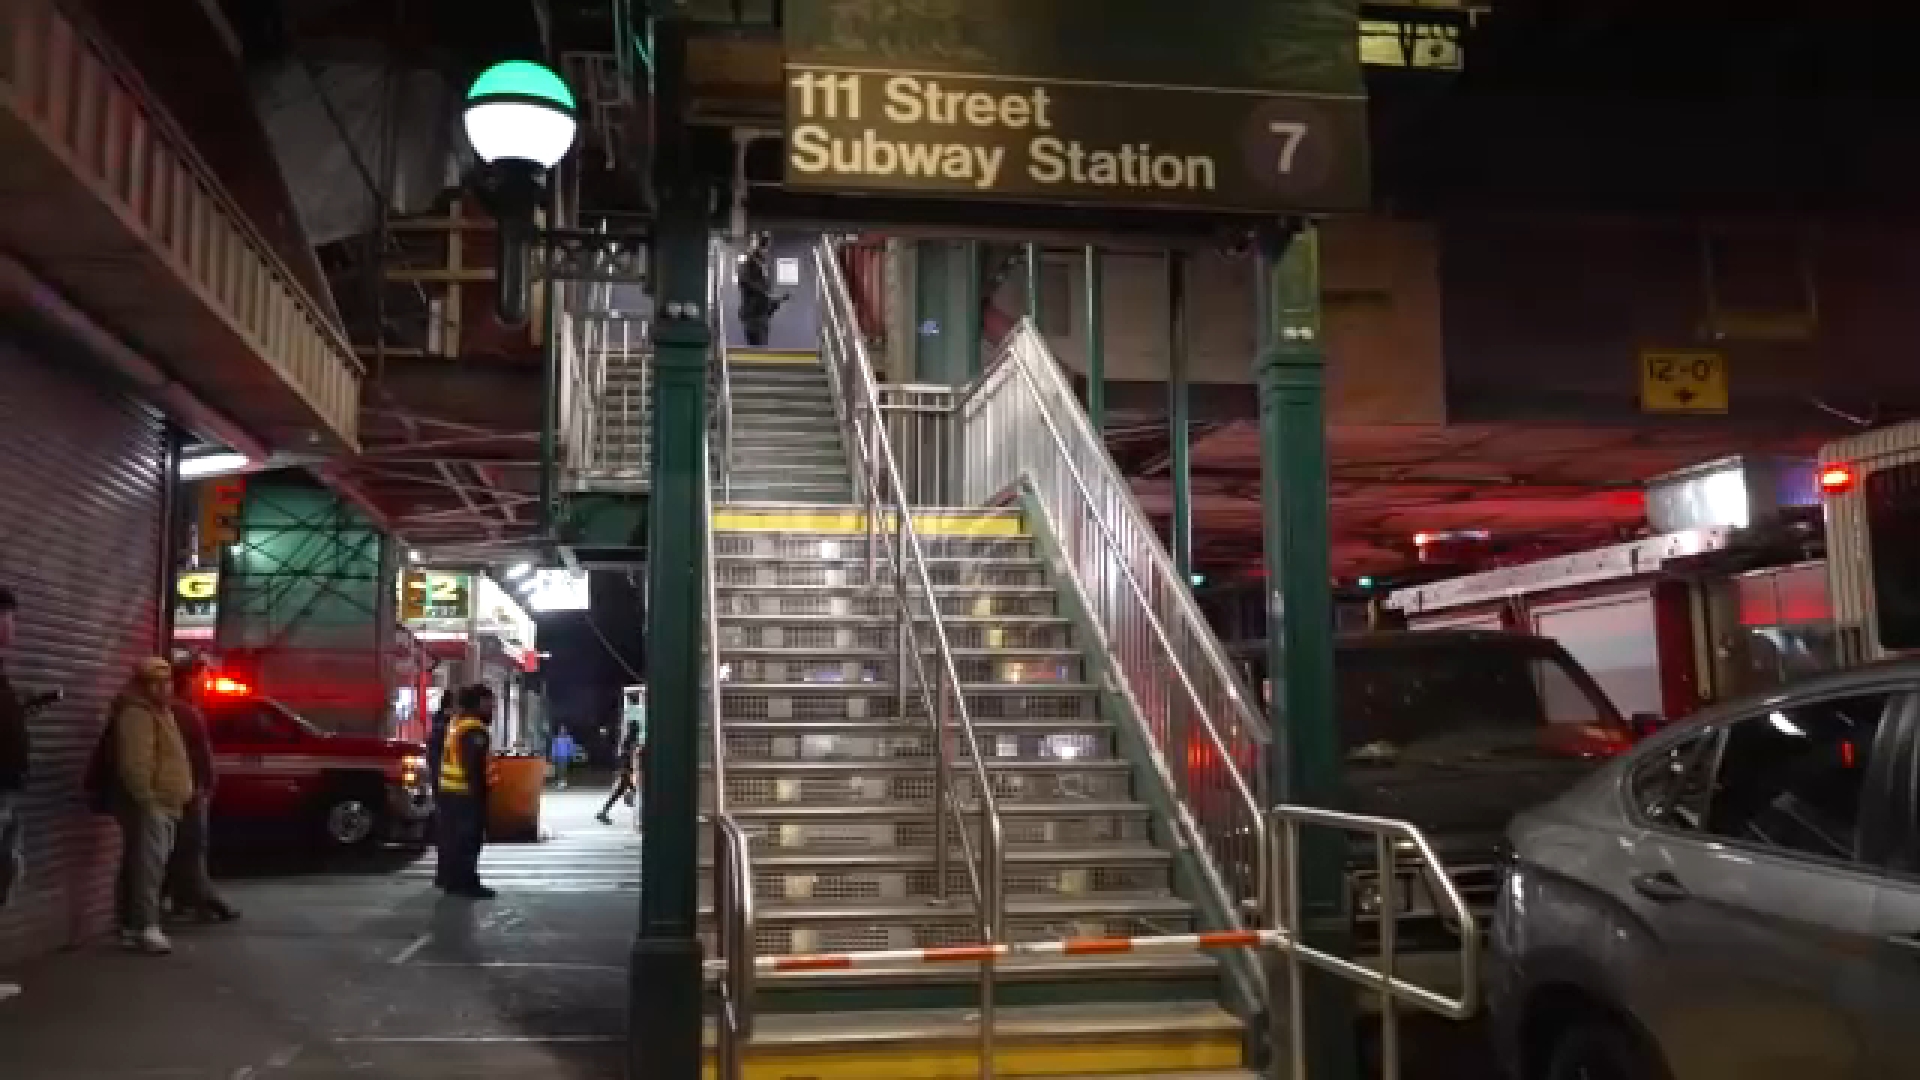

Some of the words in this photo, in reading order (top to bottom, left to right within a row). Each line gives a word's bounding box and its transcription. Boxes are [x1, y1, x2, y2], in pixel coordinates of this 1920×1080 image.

[791, 73, 861, 120] 111
[884, 77, 1051, 129] Street
[791, 126, 1004, 189] Subway
[1028, 136, 1216, 190] Station
[1268, 122, 1309, 172] 7
